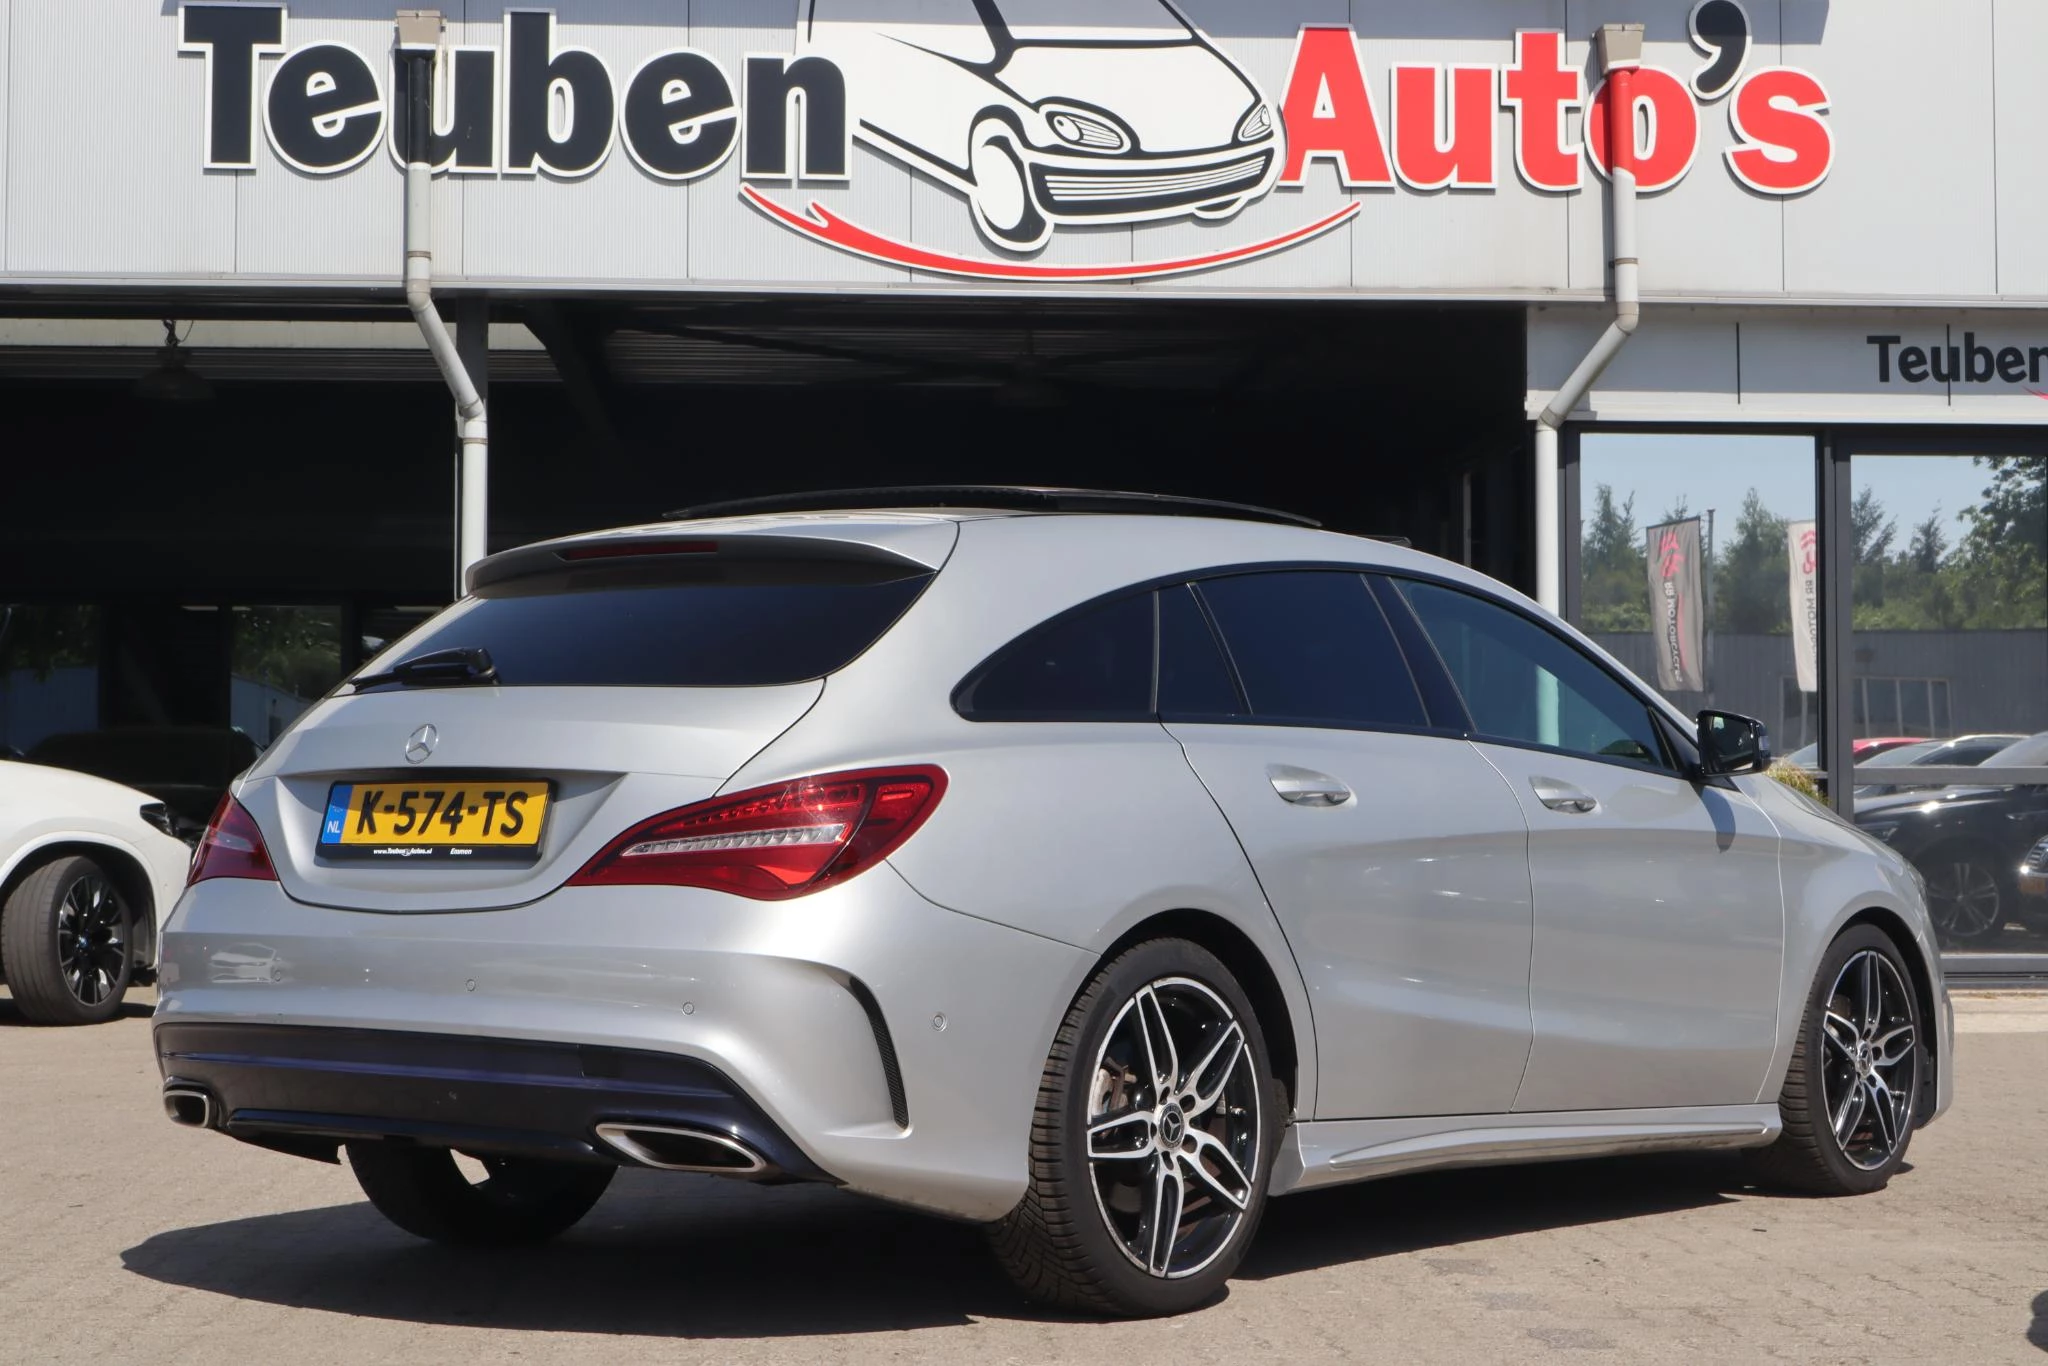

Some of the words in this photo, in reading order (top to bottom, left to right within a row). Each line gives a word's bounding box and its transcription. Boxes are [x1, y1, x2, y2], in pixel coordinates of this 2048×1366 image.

[178, 3, 851, 181] Teuben
[1272, 0, 1835, 195] Auto's
[326, 820, 341, 834] NL
[356, 790, 529, 837] K-574-TS
